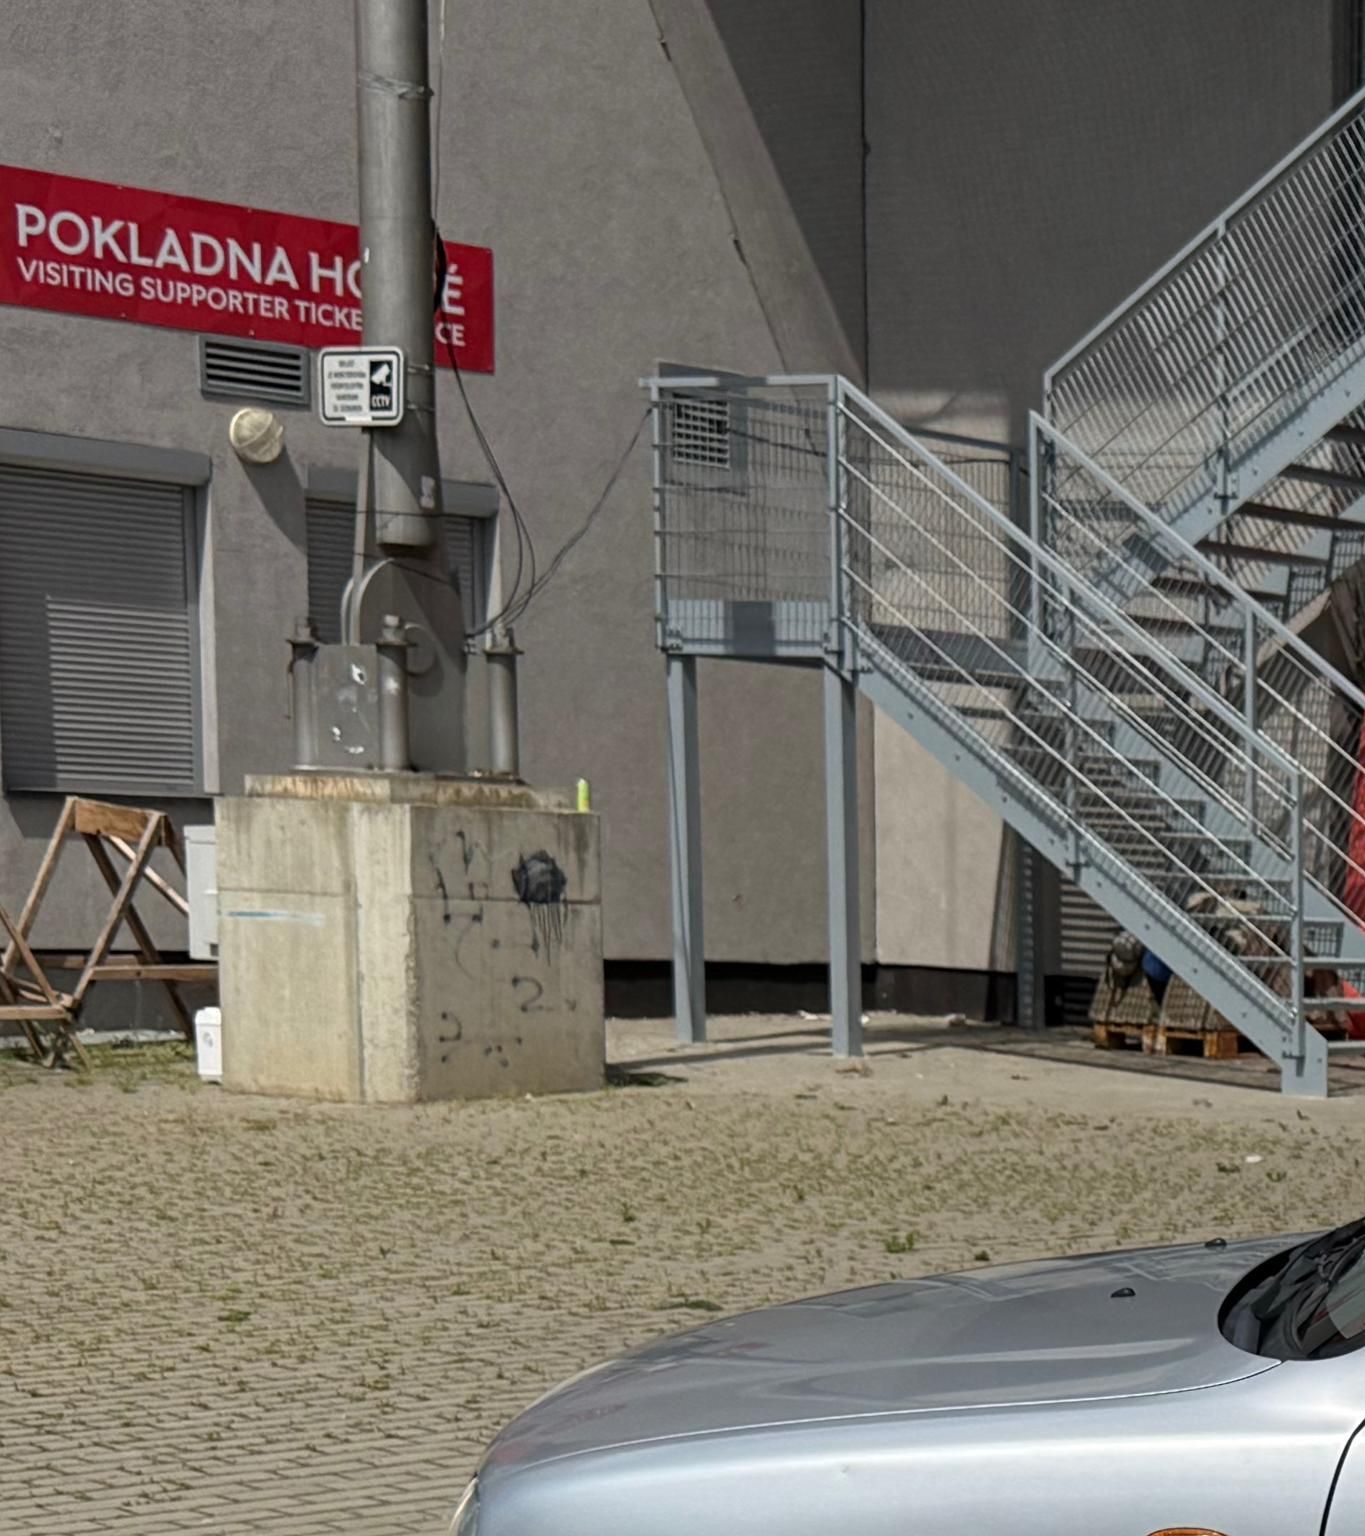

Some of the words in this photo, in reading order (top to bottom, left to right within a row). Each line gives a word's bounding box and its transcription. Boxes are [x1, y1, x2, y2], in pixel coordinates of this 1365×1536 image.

[15, 203, 299, 290] POKLADNA
[16, 256, 135, 297] VISITING
[140, 276, 290, 321] SUPPORTER
[294, 299, 363, 332] TICKE
[371, 395, 390, 407] CCTV
